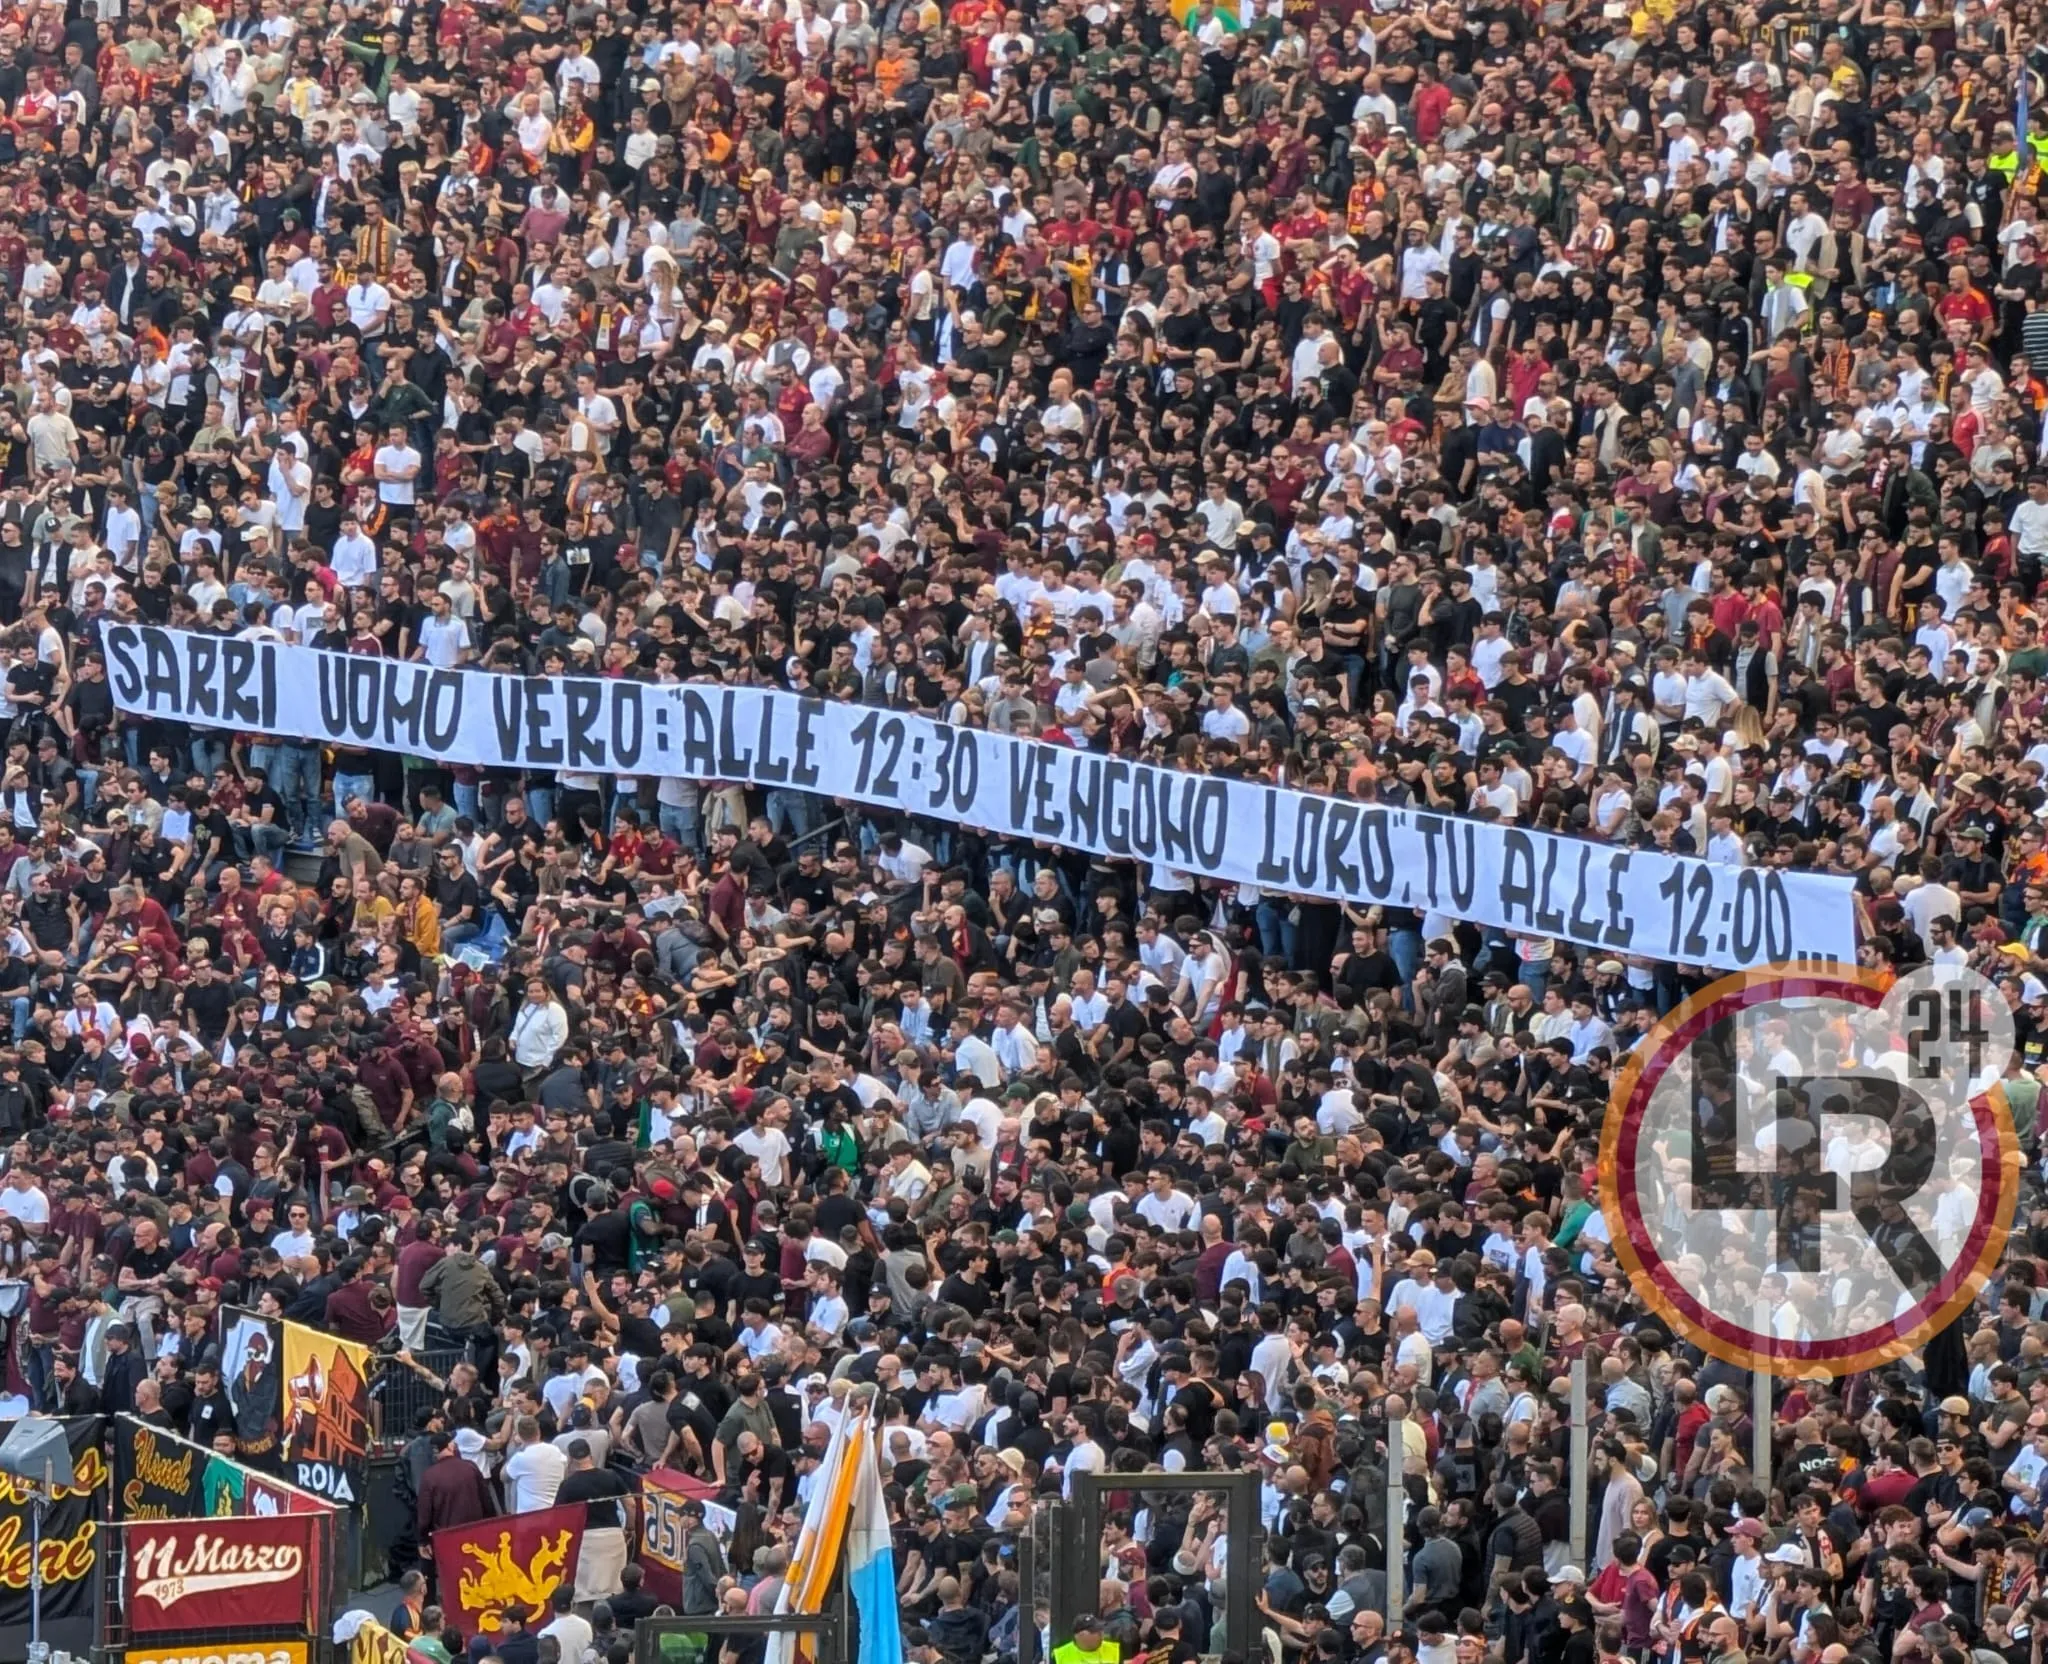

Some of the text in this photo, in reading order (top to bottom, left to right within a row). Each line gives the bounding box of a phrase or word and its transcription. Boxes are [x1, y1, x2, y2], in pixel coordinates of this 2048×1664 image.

[107, 626, 277, 728] SARRI
[318, 653, 464, 752] UOMO
[850, 711, 978, 814] 12:30
[1009, 741, 1229, 871] VENGONO
[1499, 829, 1635, 949] ALLE
[133, 1533, 302, 1580] 11 Marzo
[154, 1578, 185, 1601] 1973
